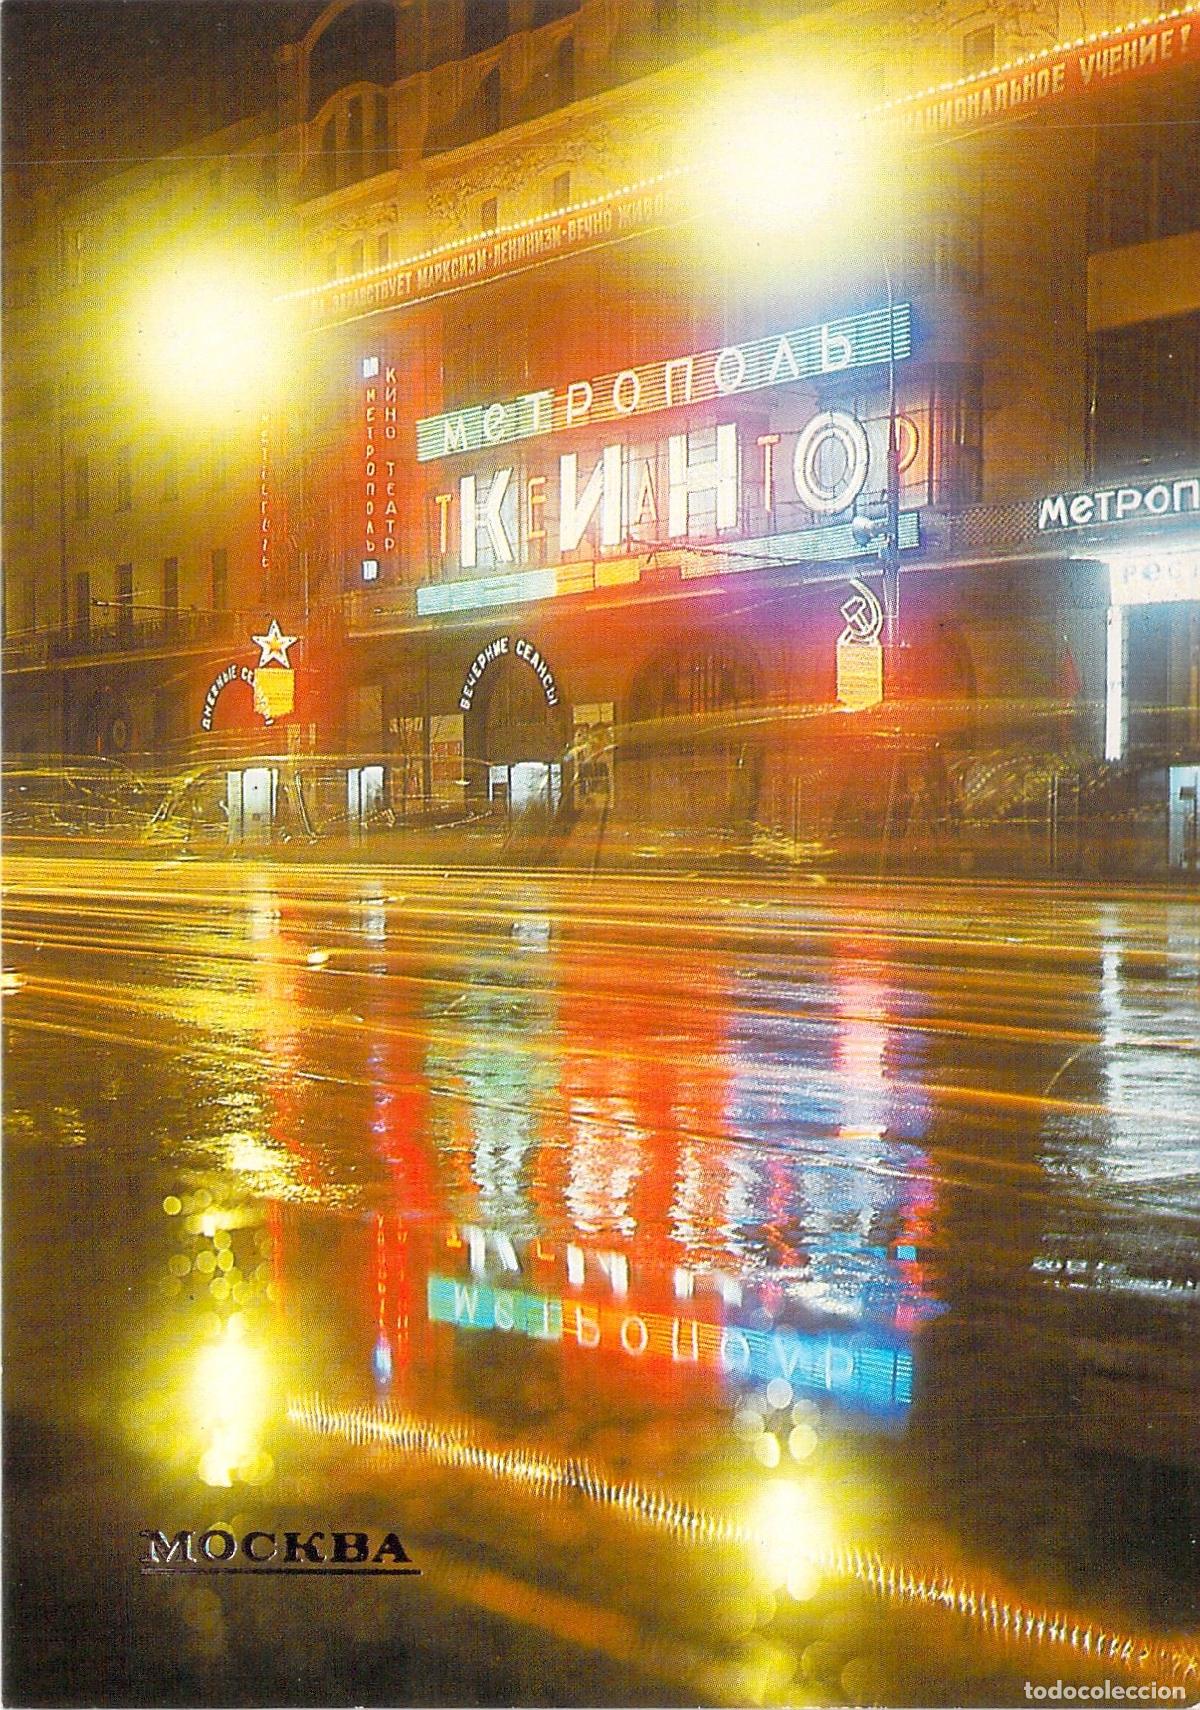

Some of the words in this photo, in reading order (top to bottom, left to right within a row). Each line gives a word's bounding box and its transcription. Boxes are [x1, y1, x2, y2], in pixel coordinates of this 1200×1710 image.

[385, 366, 397, 440] КИНО
[365, 388, 376, 552] МЕТРОПОЛЬ
[385, 461, 398, 551] ТЕАТР
[459, 637, 509, 711] ВЕЧЕРНИЕ
[515, 639, 559, 706] СЕАНСЫ
